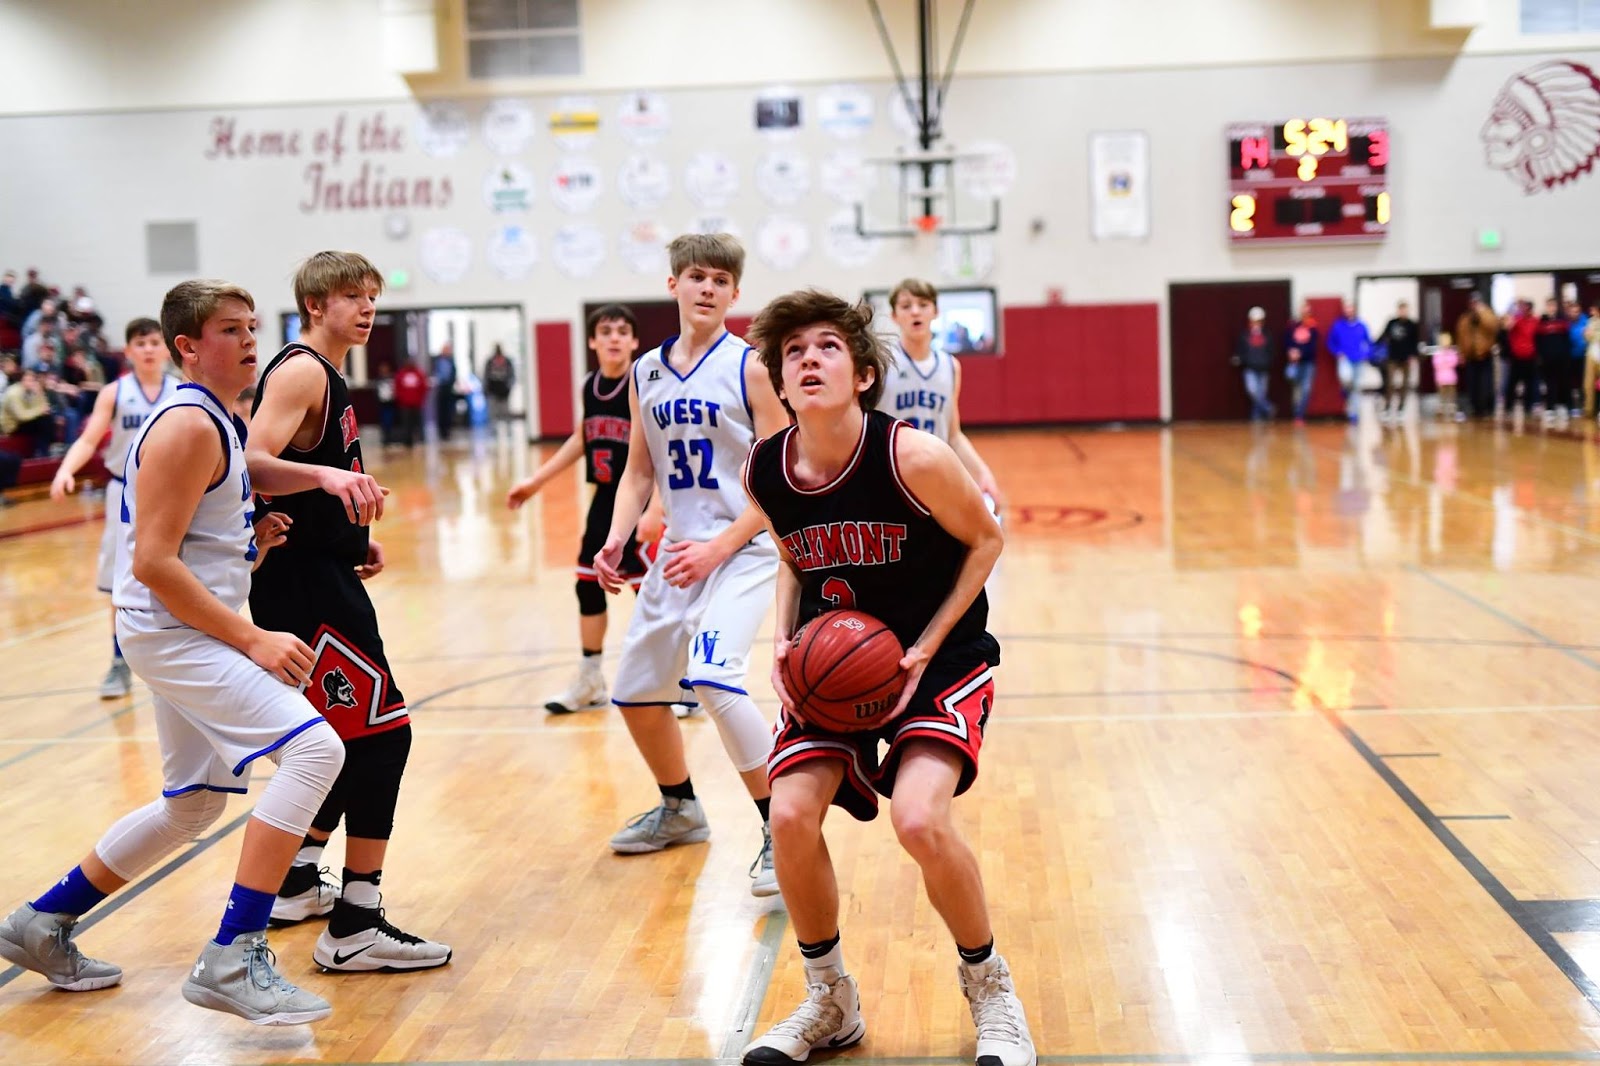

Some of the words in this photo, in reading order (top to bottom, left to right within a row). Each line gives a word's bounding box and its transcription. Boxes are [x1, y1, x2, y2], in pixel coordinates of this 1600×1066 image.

[205, 116, 303, 159] Home
[313, 113, 347, 165] of
[357, 111, 405, 152] the
[1367, 130, 1390, 166] 3
[299, 162, 454, 212] Indians
[1230, 194, 1256, 232] 2
[1376, 191, 1391, 225] 1
[652, 398, 720, 431] WEST
[896, 389, 946, 414] WEST
[592, 449, 612, 484] 5
[667, 438, 719, 490] 32
[780, 521, 907, 572] ELKMONT
